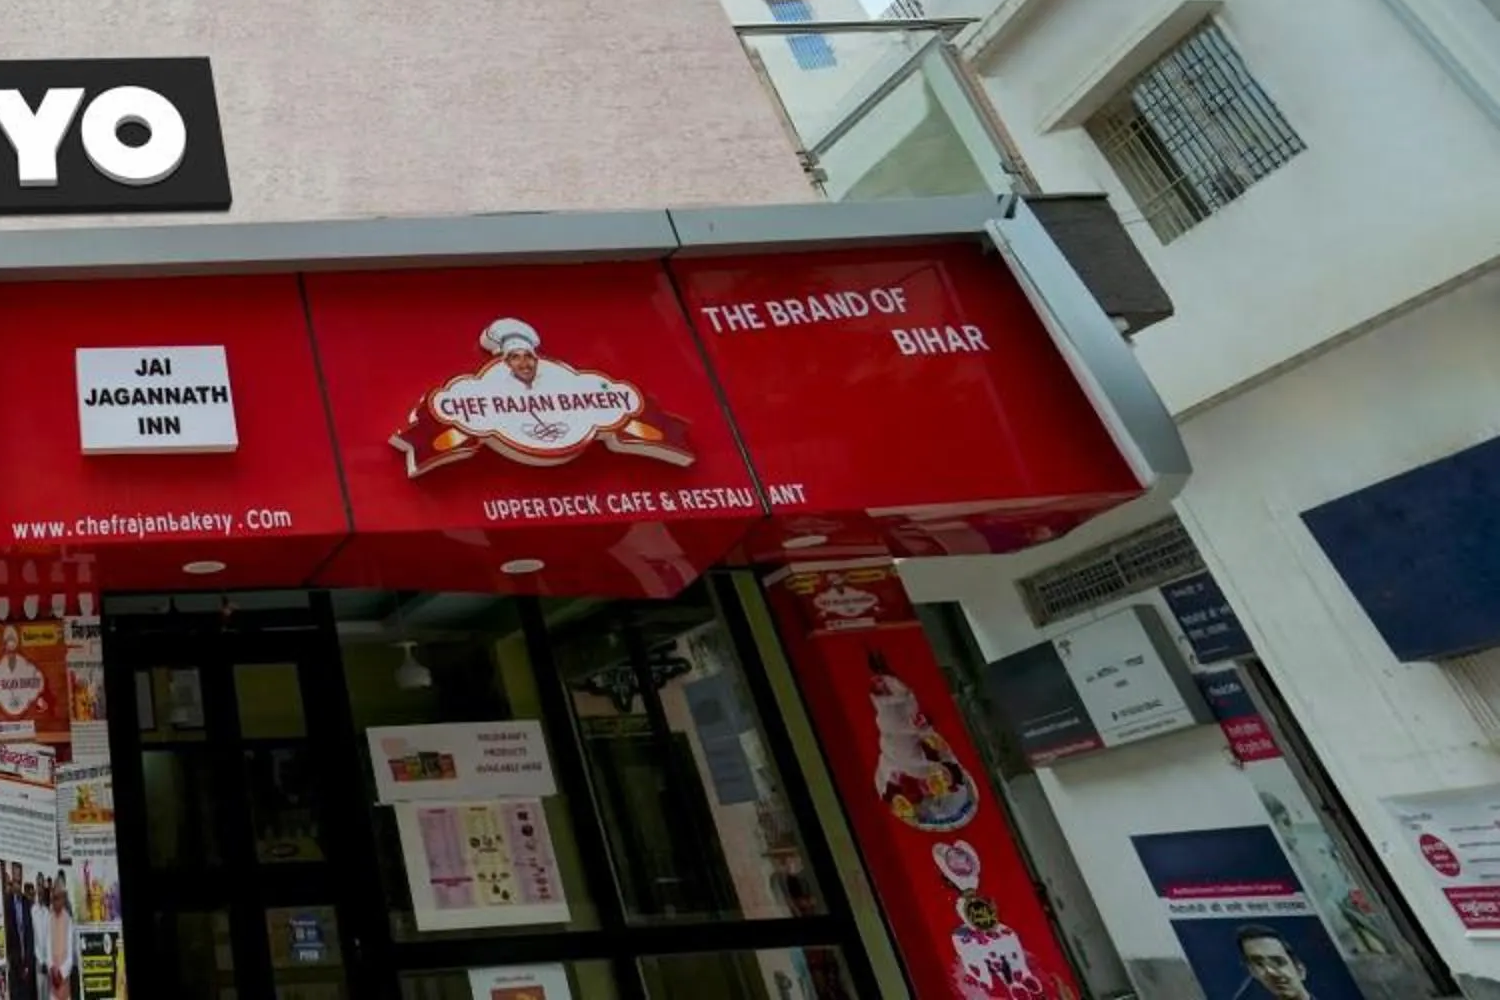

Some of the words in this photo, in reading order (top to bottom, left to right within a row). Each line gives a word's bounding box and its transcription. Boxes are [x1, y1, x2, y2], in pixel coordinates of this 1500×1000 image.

[702, 303, 765, 333] THE
[766, 291, 870, 327] BRAND
[870, 287, 908, 314] OF
[891, 324, 990, 356] BIHAR
[135, 357, 172, 377] JAI
[84, 385, 229, 407] JAGANNATH
[440, 396, 489, 422] CHEF
[492, 395, 556, 414] RAJAN
[557, 391, 632, 411] BAKERY
[137, 415, 181, 435] INN
[484, 498, 549, 521] UPPER
[550, 494, 601, 517] DECK
[606, 491, 657, 514] CAFE
[659, 490, 677, 512] &
[681, 484, 807, 510] RESTAUANT
